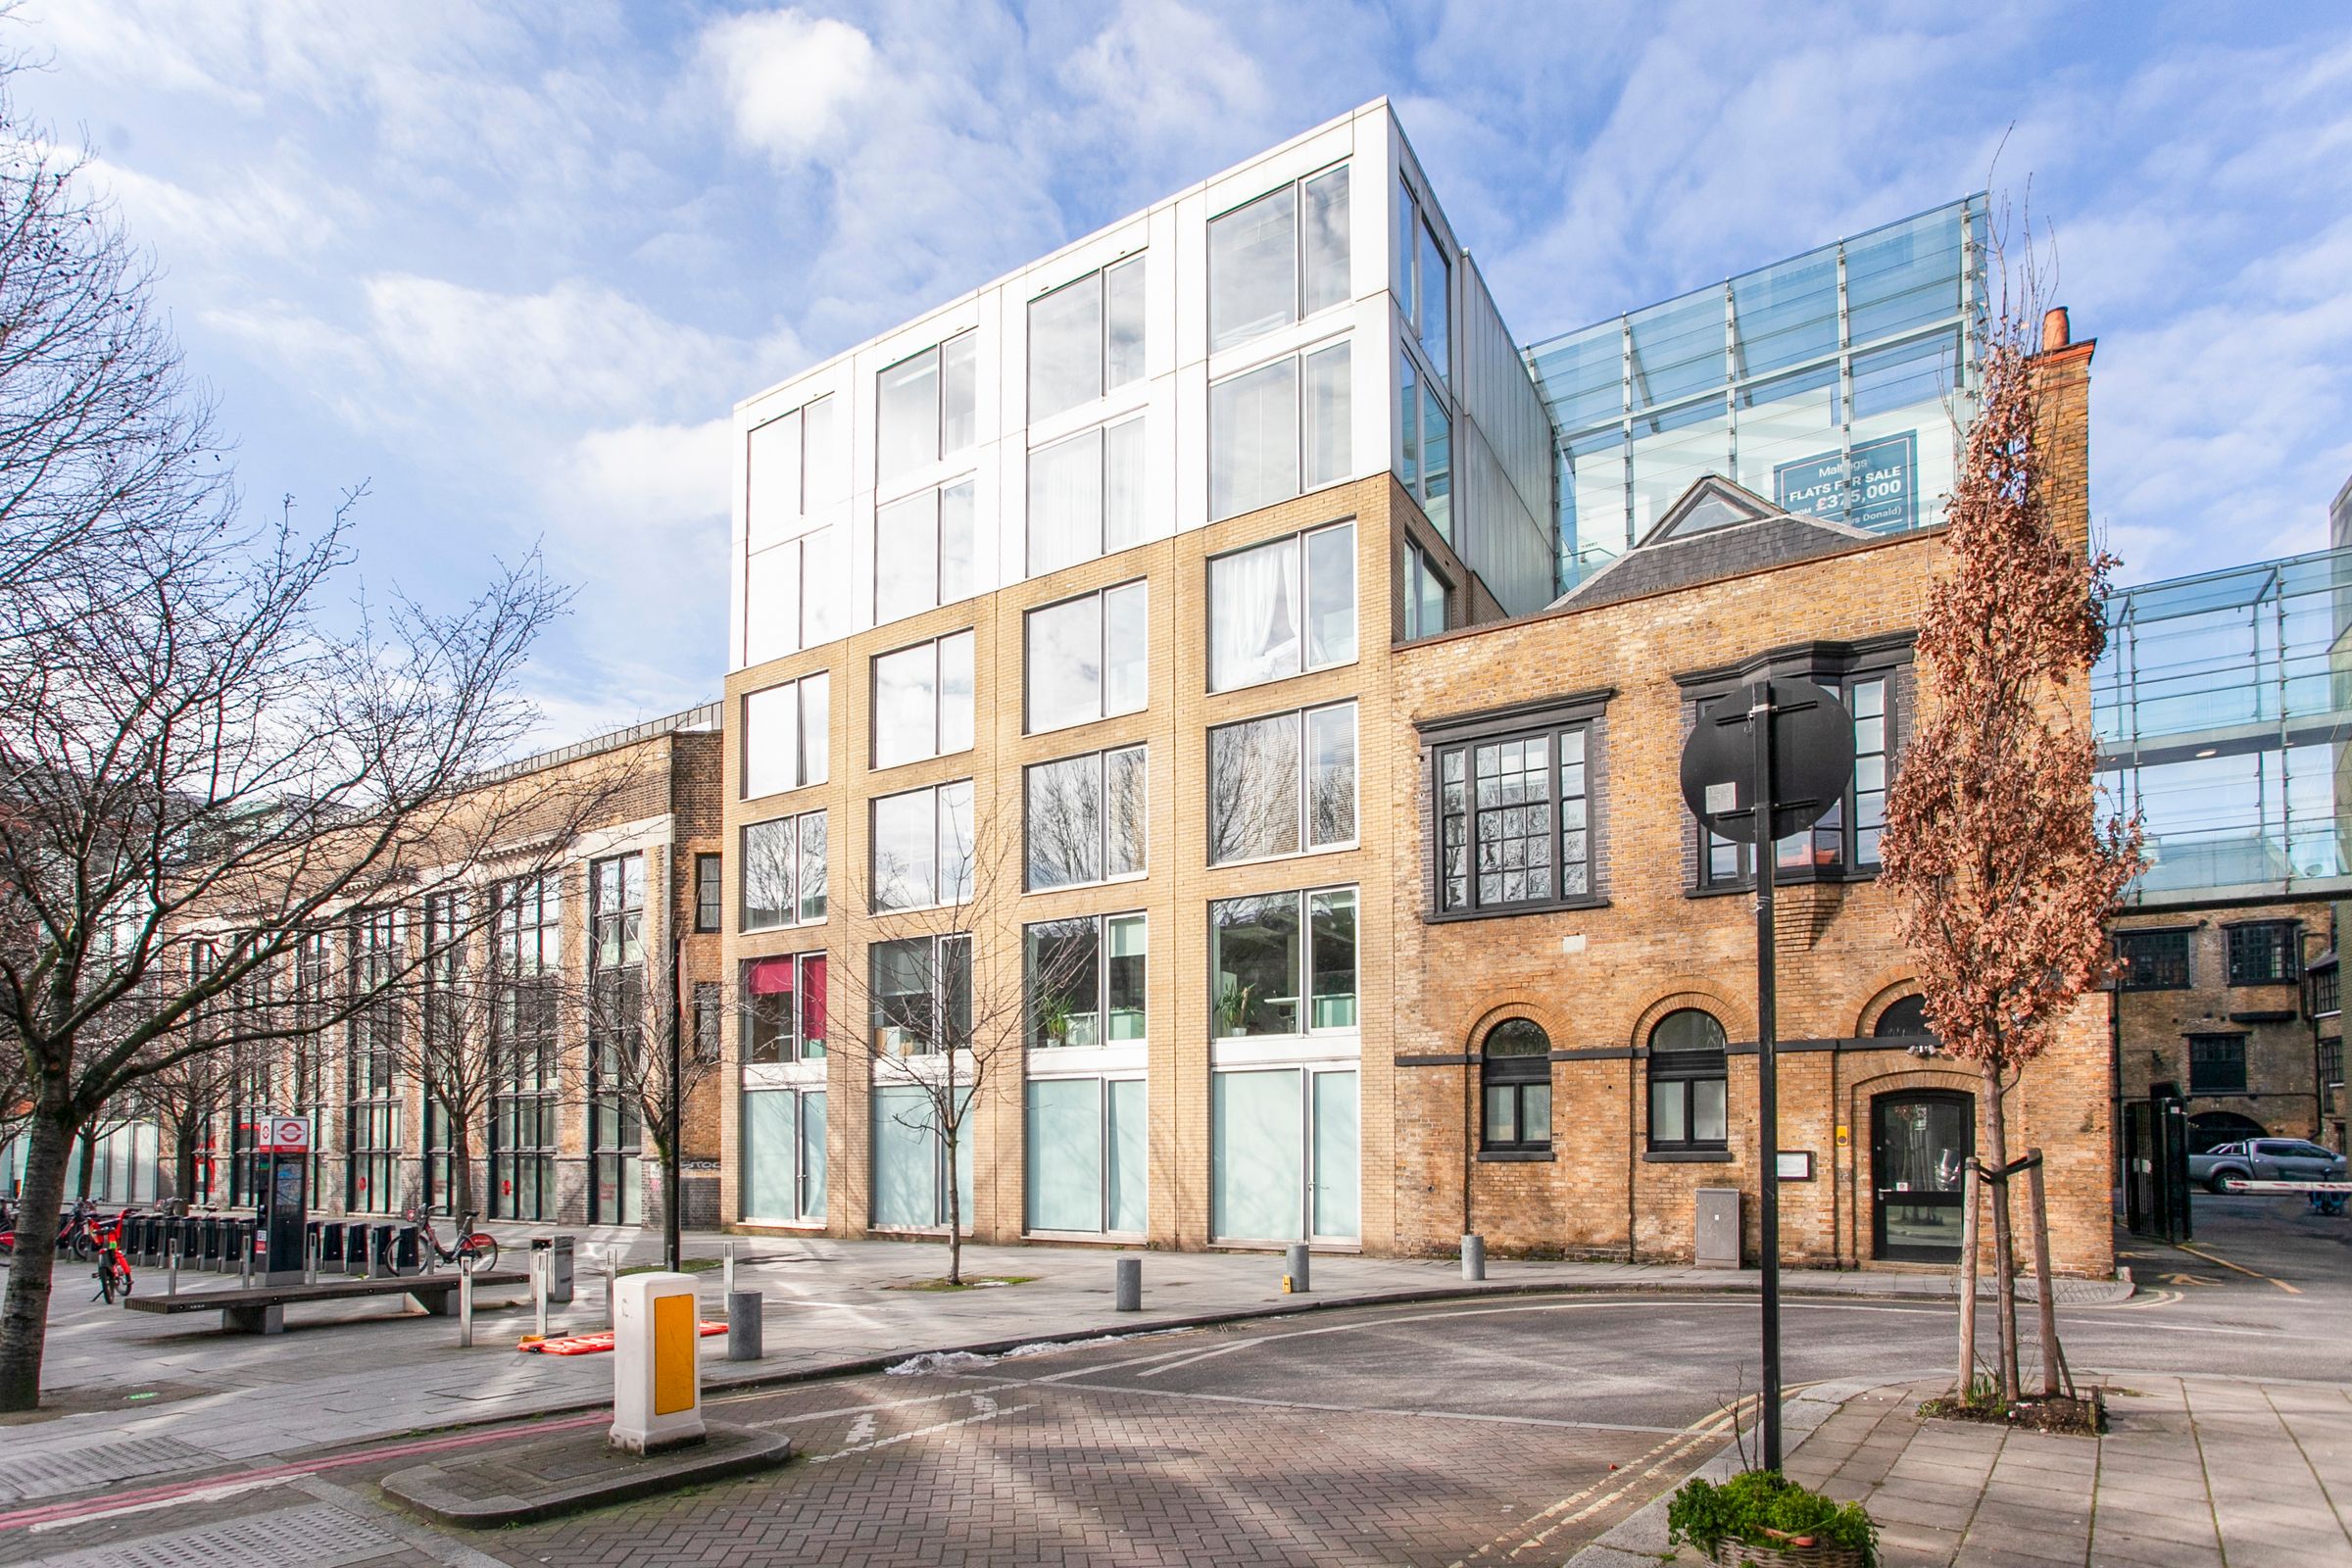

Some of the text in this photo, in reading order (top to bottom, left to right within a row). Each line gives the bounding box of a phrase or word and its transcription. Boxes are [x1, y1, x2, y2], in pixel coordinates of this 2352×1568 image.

[1819, 459, 1868, 477] Maltgs
[1789, 466, 1901, 503] FLATS FR SALE
[1863, 505, 1902, 522] Donald)
